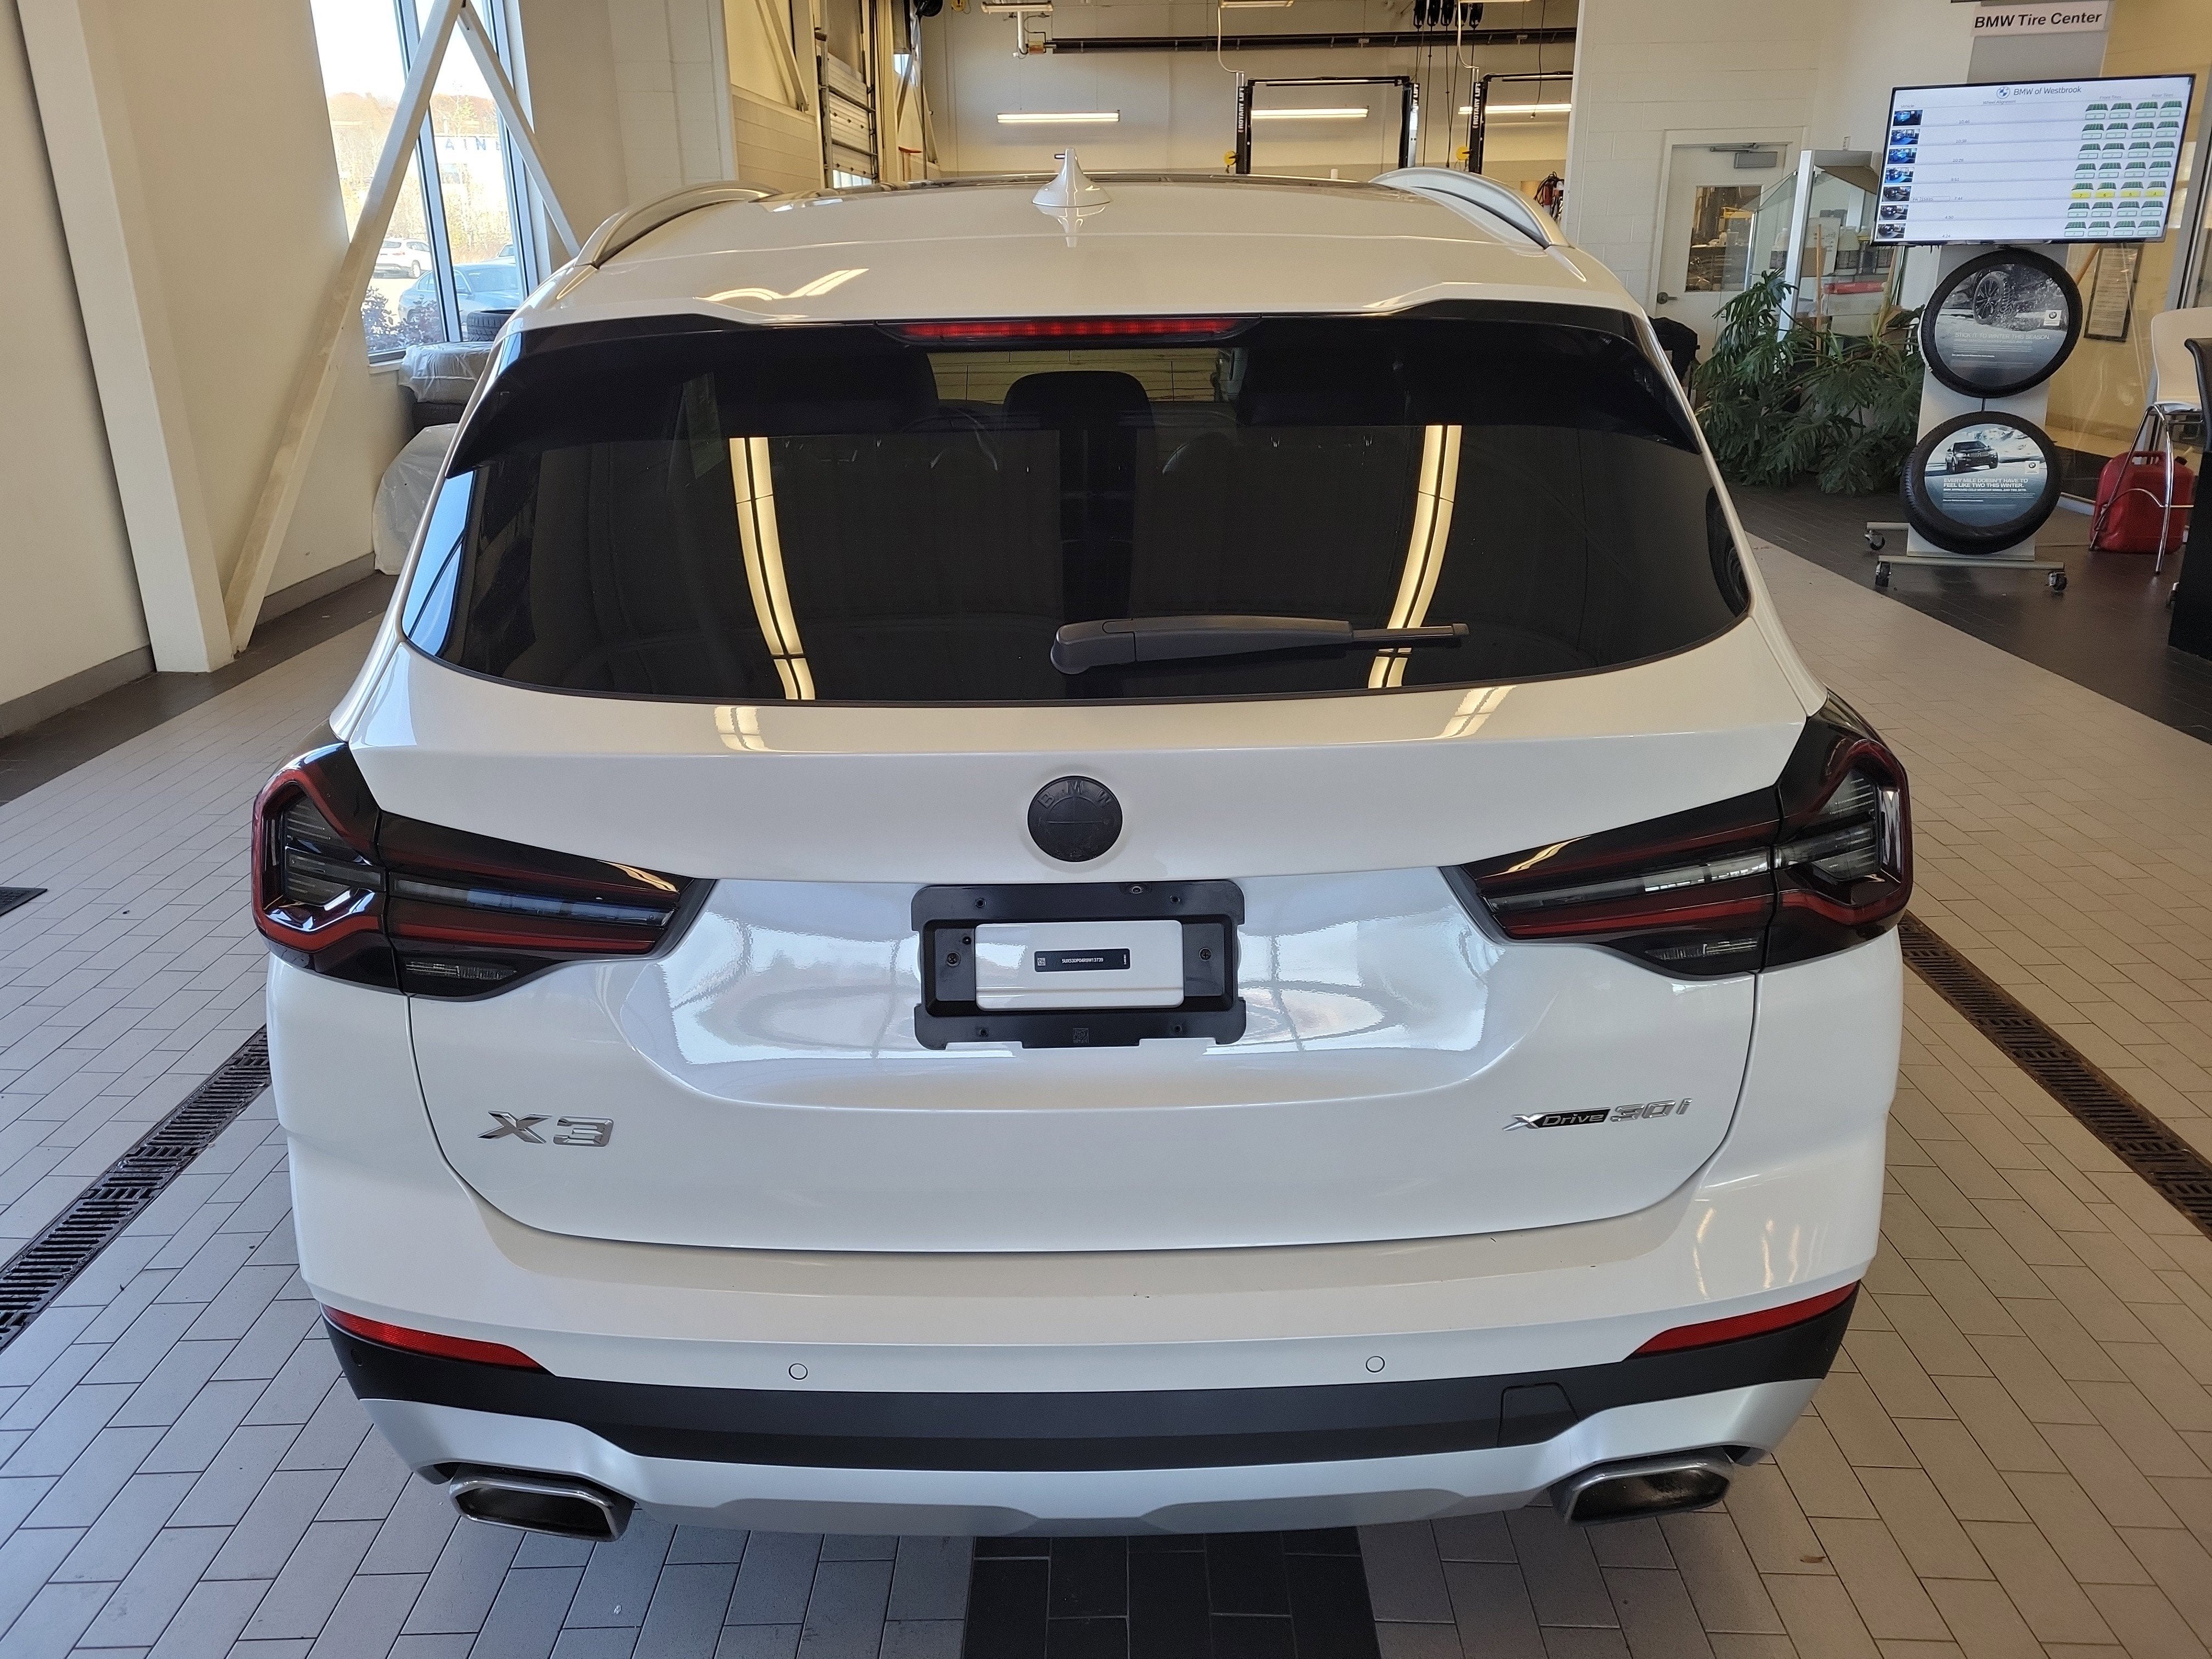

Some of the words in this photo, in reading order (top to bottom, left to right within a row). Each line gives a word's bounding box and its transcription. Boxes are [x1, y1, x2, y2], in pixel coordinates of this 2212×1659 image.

[1974, 14, 2016, 29] BMW
[2018, 13, 2046, 26] Tire
[2051, 12, 2102, 25] Center
[2044, 86, 2082, 94] Westbrook
[1037, 780, 1111, 809] BMW
[1610, 1097, 1693, 1122] 30i
[477, 1110, 614, 1147] X3
